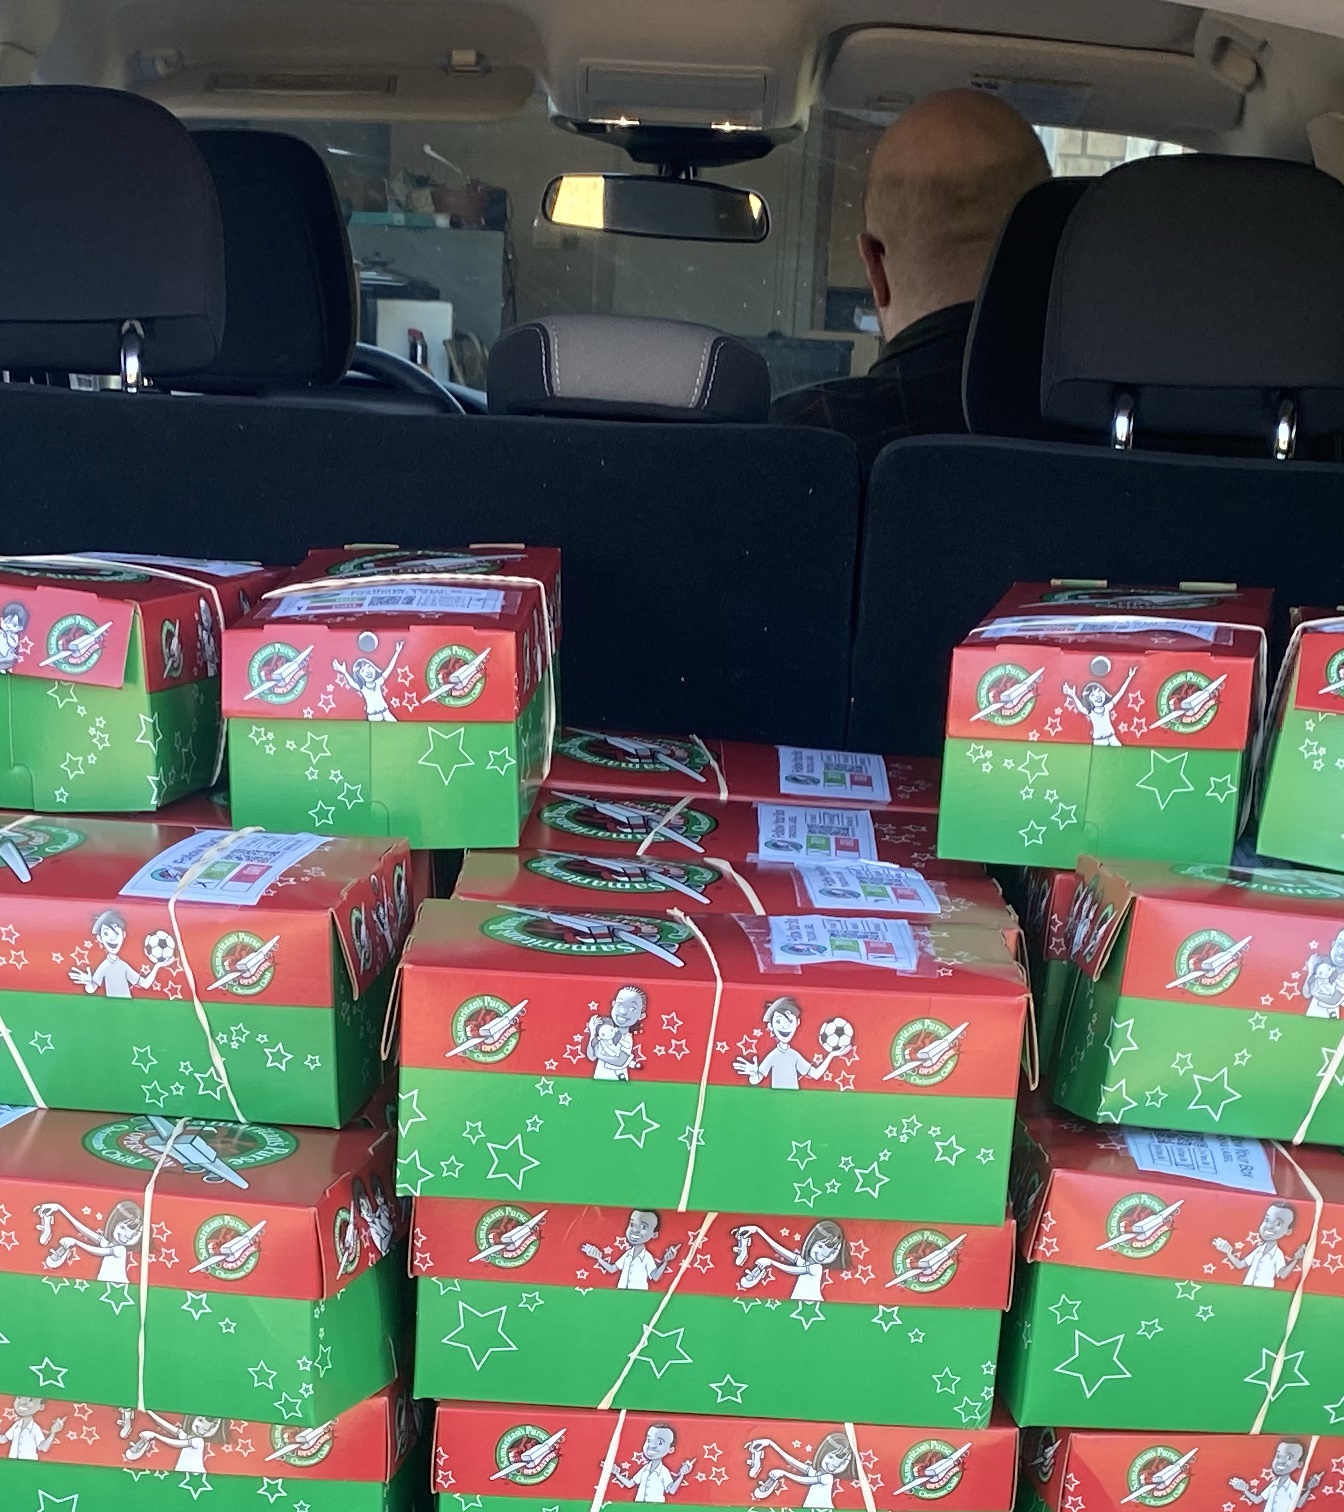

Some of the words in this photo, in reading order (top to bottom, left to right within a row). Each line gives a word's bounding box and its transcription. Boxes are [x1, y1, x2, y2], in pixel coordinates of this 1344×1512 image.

[1006, 665, 1026, 680] Purse
[1187, 672, 1207, 688] Purse
[239, 932, 263, 950] Purse
[1210, 930, 1233, 948] Purse
[484, 996, 509, 1013] Purse
[924, 1019, 949, 1036] Purse
[102, 1149, 144, 1166] Child
[227, 1147, 290, 1165] Purse
[1141, 1195, 1164, 1211] Purse
[505, 1207, 528, 1223] Purse
[224, 1215, 247, 1233] Purse
[923, 1231, 946, 1247] Purse
[526, 1425, 549, 1441] Purse
[930, 1440, 953, 1456] Purse
[1157, 1447, 1180, 1463] Purse
